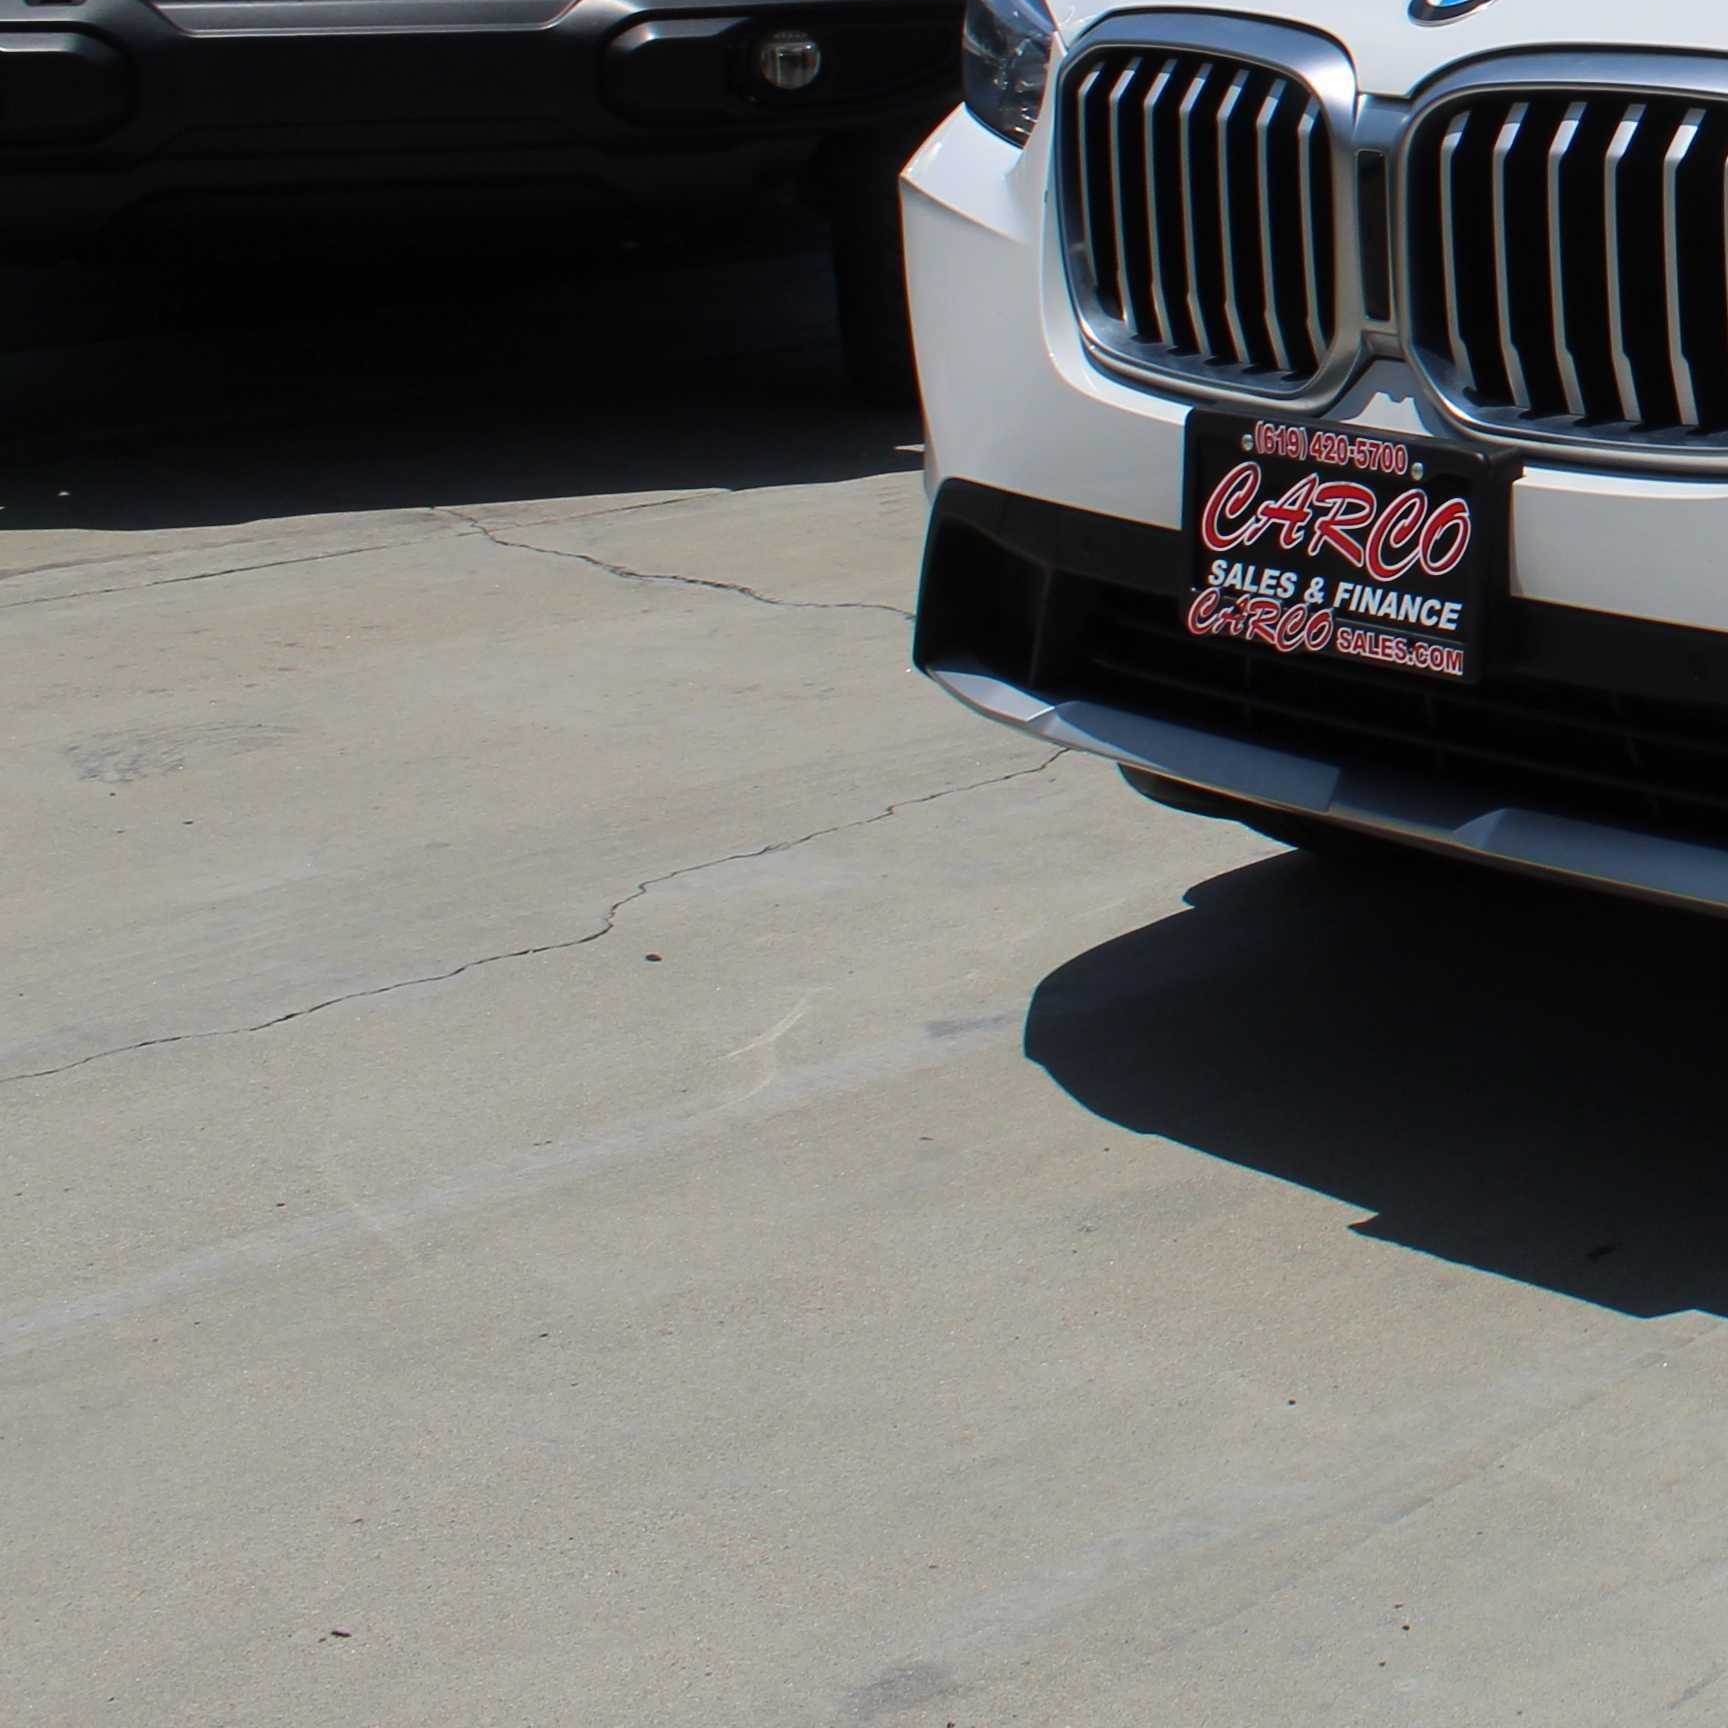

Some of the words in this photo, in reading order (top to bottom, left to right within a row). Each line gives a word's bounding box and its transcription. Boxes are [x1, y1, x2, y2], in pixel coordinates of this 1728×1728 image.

[1255, 420, 1308, 461] (619)
[1310, 432, 1408, 475] 420-5700
[1201, 460, 1472, 582] CARCO
[1188, 587, 1334, 652] CARCO
[1336, 627, 1465, 676] SALES.COM
[1207, 559, 1298, 599] SALES
[1303, 576, 1325, 604] &
[1332, 582, 1463, 631] FINANCE
